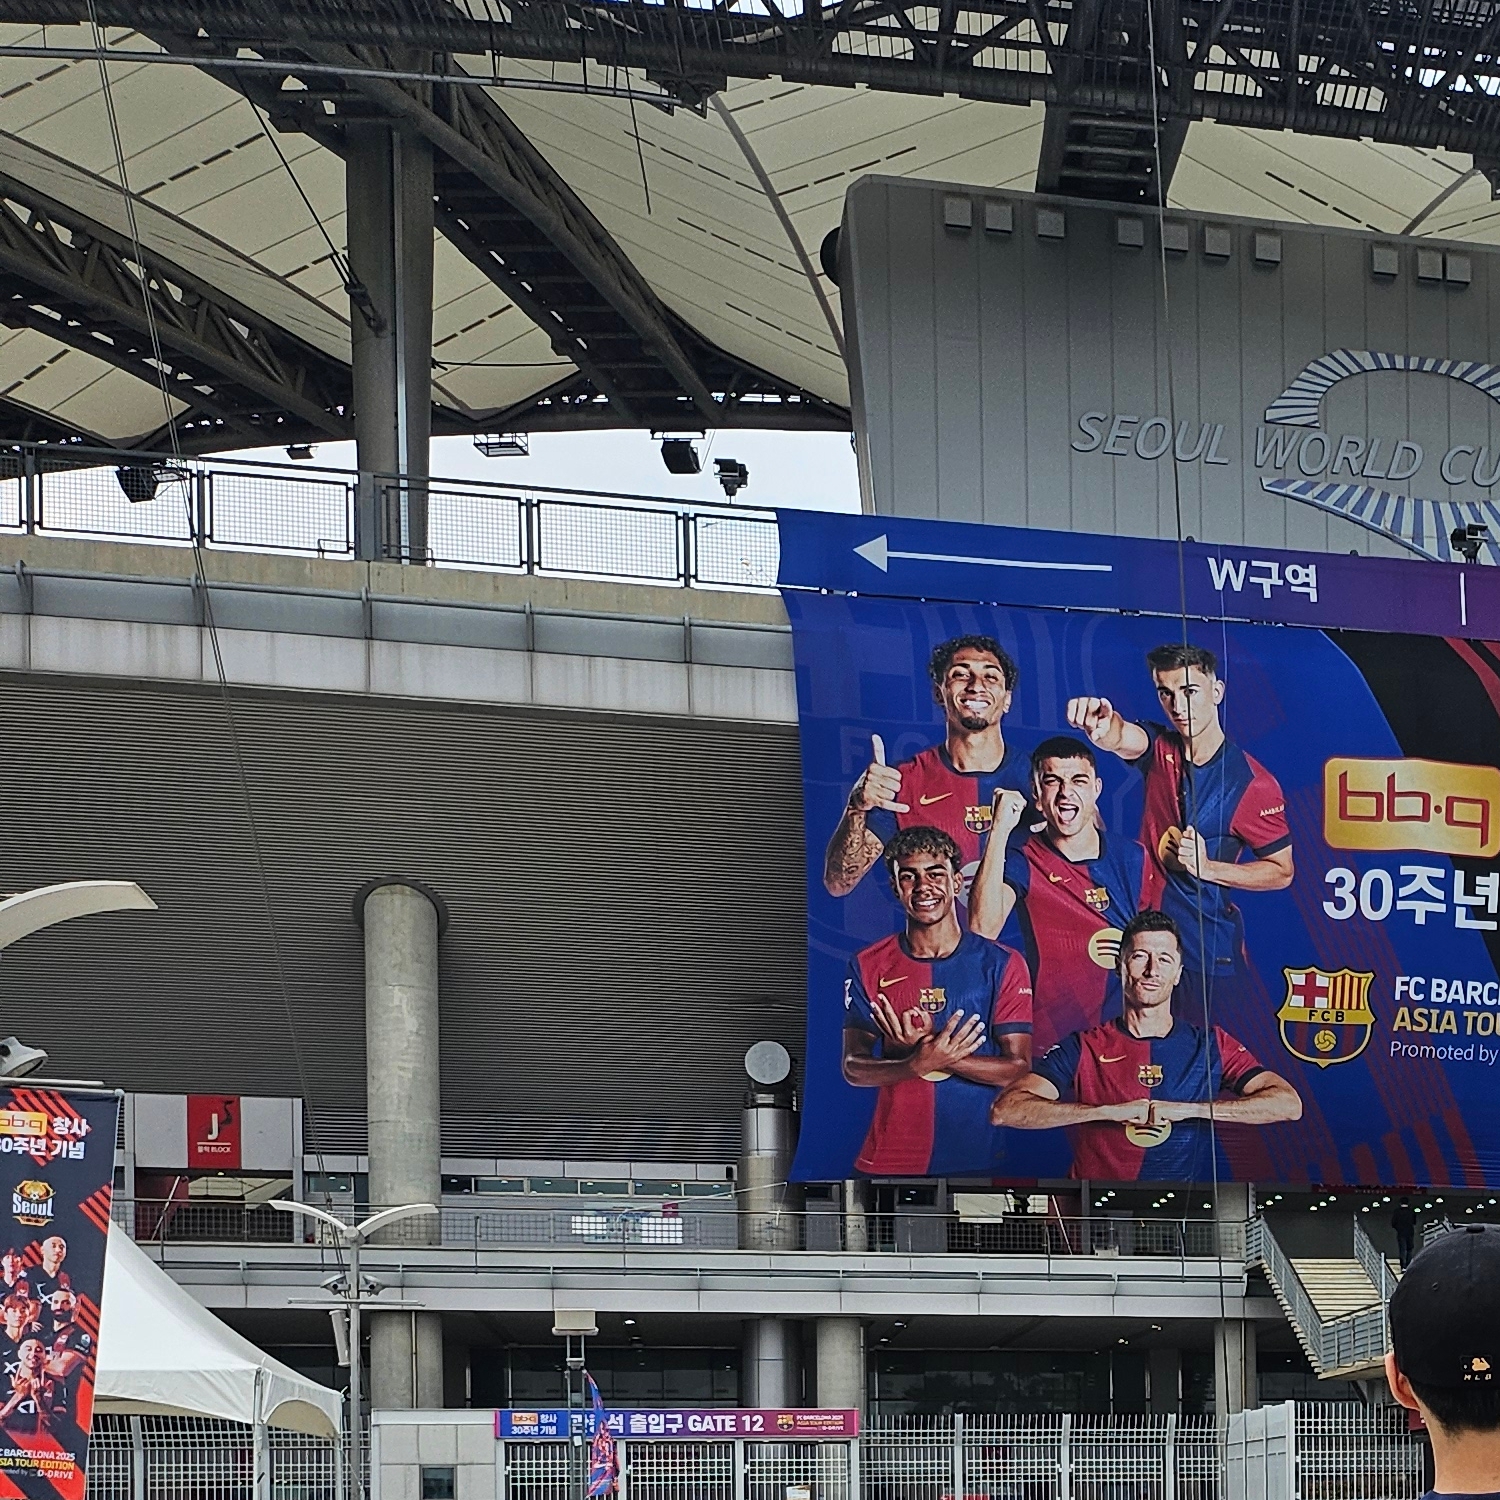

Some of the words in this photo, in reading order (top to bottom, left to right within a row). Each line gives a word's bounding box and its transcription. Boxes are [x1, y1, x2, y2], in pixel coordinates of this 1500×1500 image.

[1071, 411, 1229, 465] SEOUL
[1254, 425, 1425, 482] WORLD
[1207, 556, 1318, 603] W구역
[1394, 975, 1426, 1002] FC
[1393, 1007, 1458, 1035] ASIA
[1389, 1040, 1476, 1063] Promoted
[1479, 1043, 1498, 1066] by
[53, 1116, 90, 1137] 창사
[207, 1113, 219, 1141] J
[50, 1139, 85, 1160] 기념
[12, 1192, 54, 1217] Seoul
[511, 1425, 538, 1435] 30주년
[629, 1413, 683, 1434] 출입구
[687, 1414, 737, 1432] GATE
[741, 1414, 765, 1432] 12
[0, 1457, 14, 1467] SIA
[15, 1458, 39, 1468] TOUR
[40, 1460, 75, 1471] EDITION
[4, 1448, 55, 1460] BARCELONA
[55, 1450, 76, 1462] 2025
[37, 1469, 74, 1480] D-DRIVE
